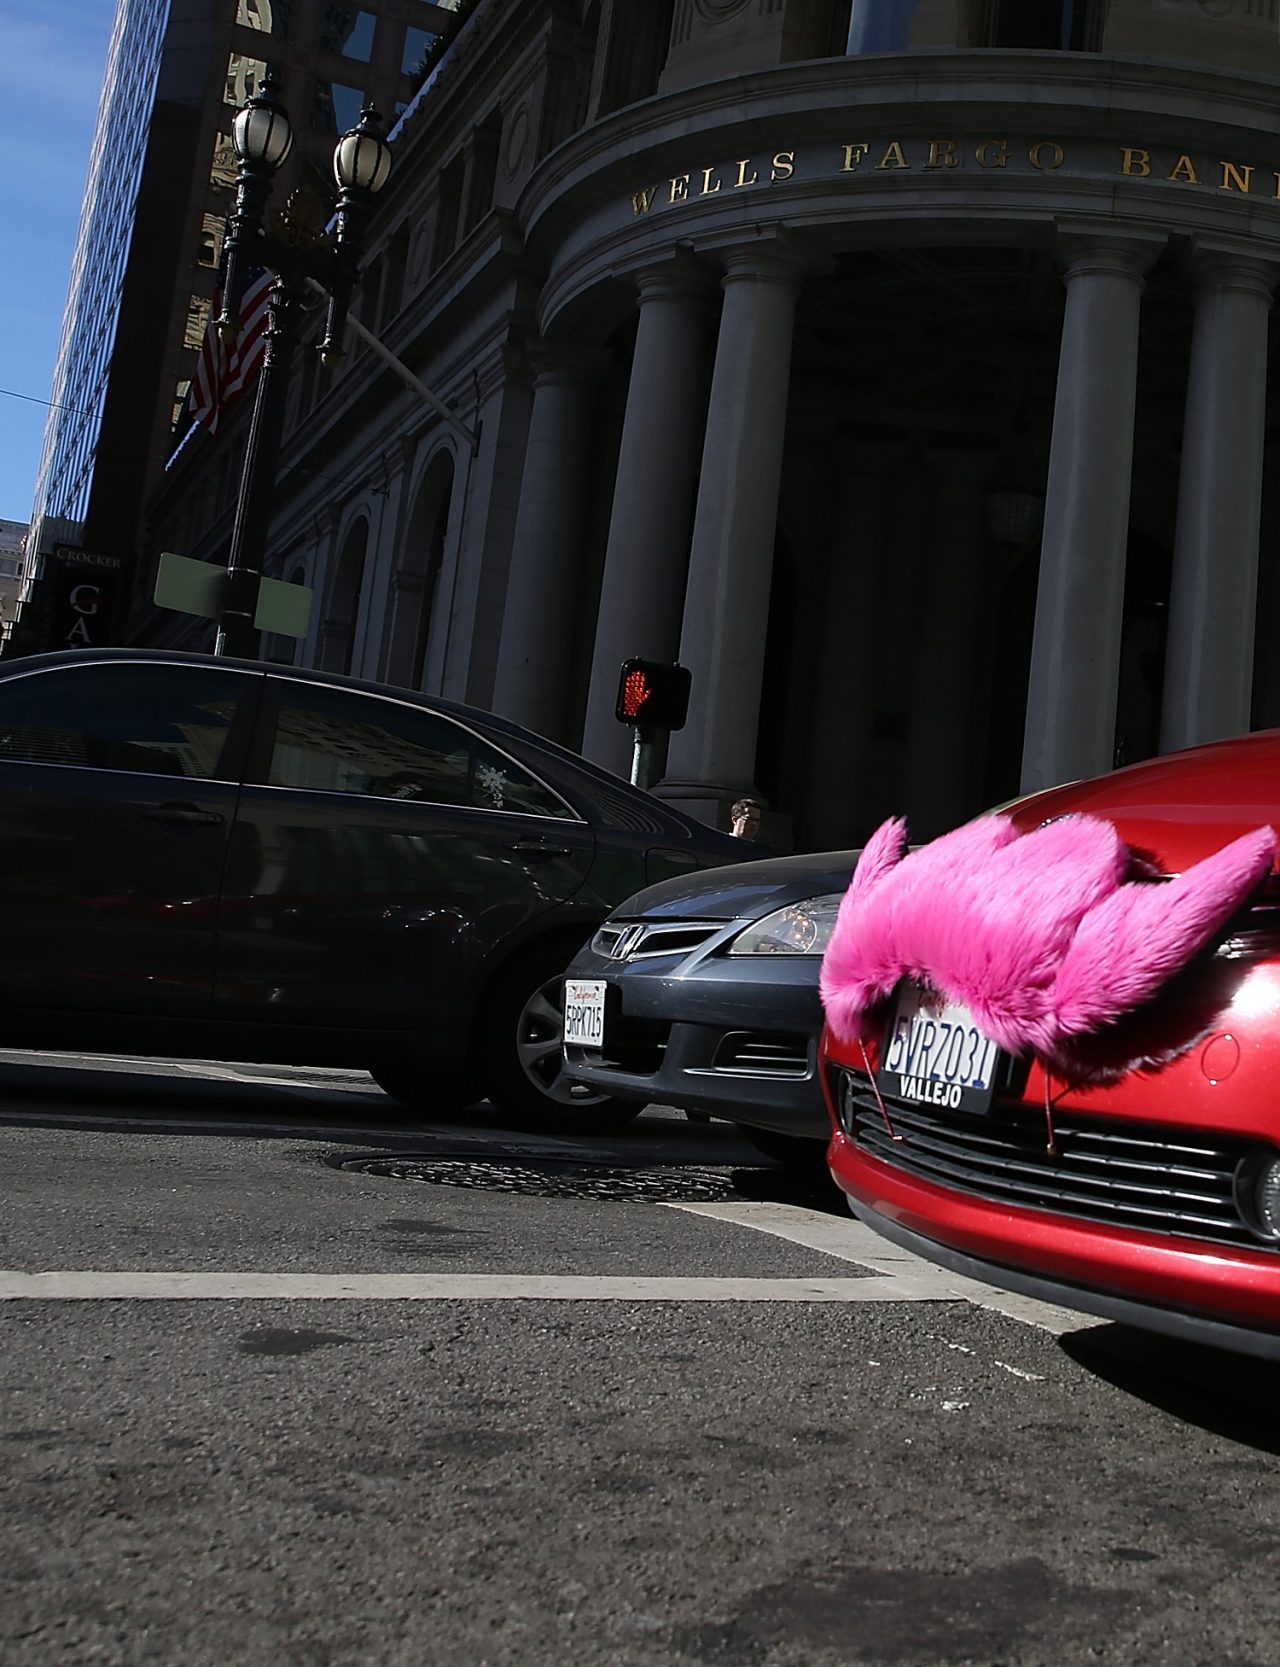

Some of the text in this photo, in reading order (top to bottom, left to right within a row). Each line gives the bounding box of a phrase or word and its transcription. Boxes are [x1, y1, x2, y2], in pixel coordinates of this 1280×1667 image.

[630, 151, 798, 216] WELLS
[838, 140, 1066, 173] FARGO
[56, 548, 121, 569] CROCKER
[566, 1005, 602, 1037] 5RPK715
[890, 1016, 990, 1089] 5VRZ031
[900, 1075, 962, 1109] VALLEJO
